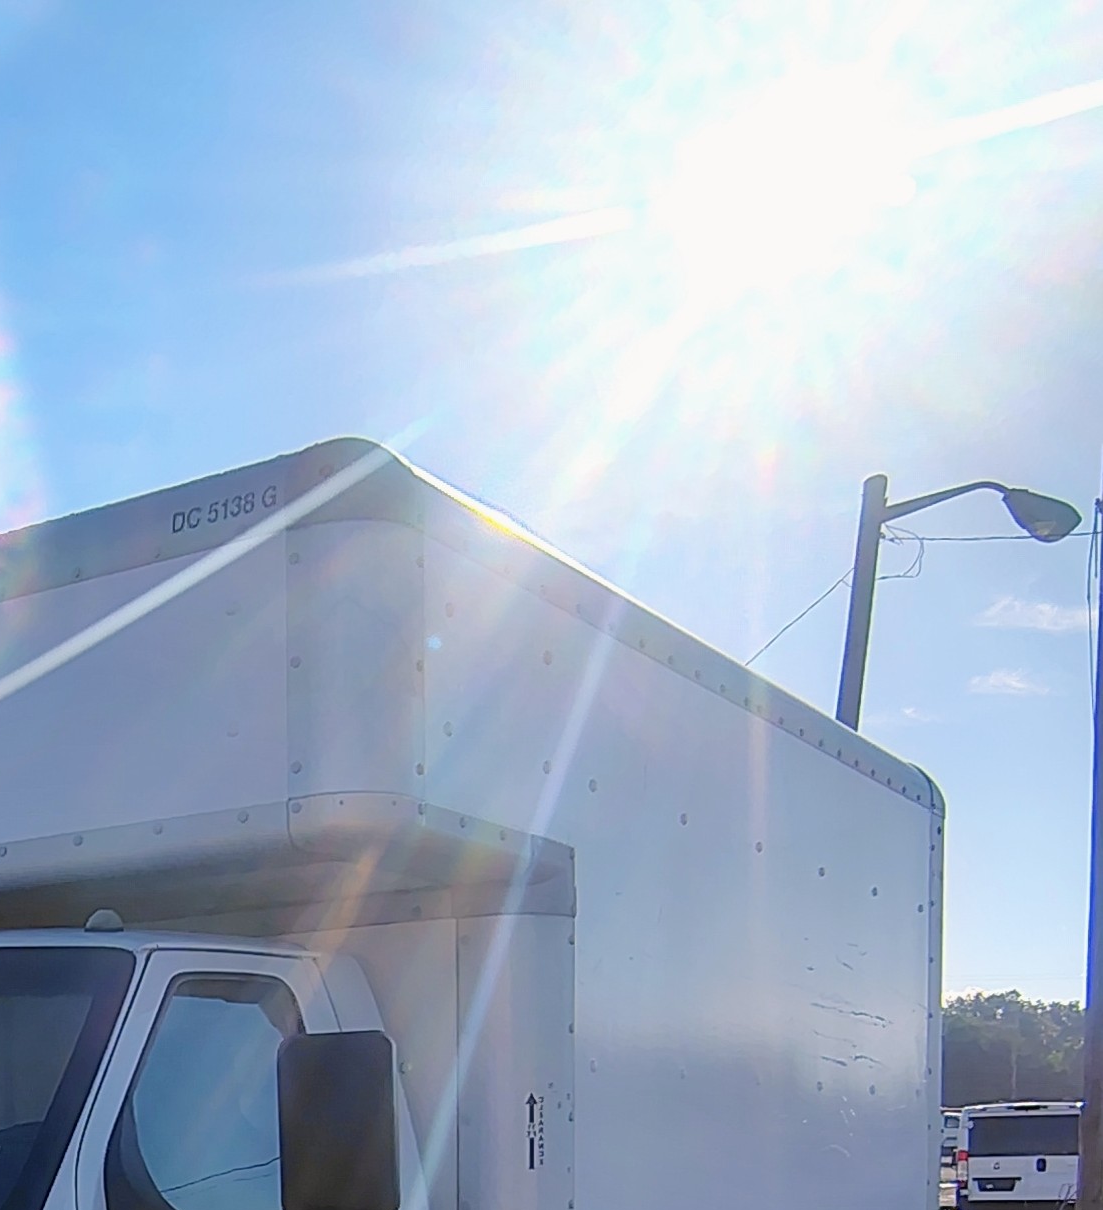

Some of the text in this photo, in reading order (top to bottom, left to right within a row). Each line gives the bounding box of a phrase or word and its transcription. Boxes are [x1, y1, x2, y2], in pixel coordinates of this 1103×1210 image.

[172, 485, 277, 533] DC 5138 G
